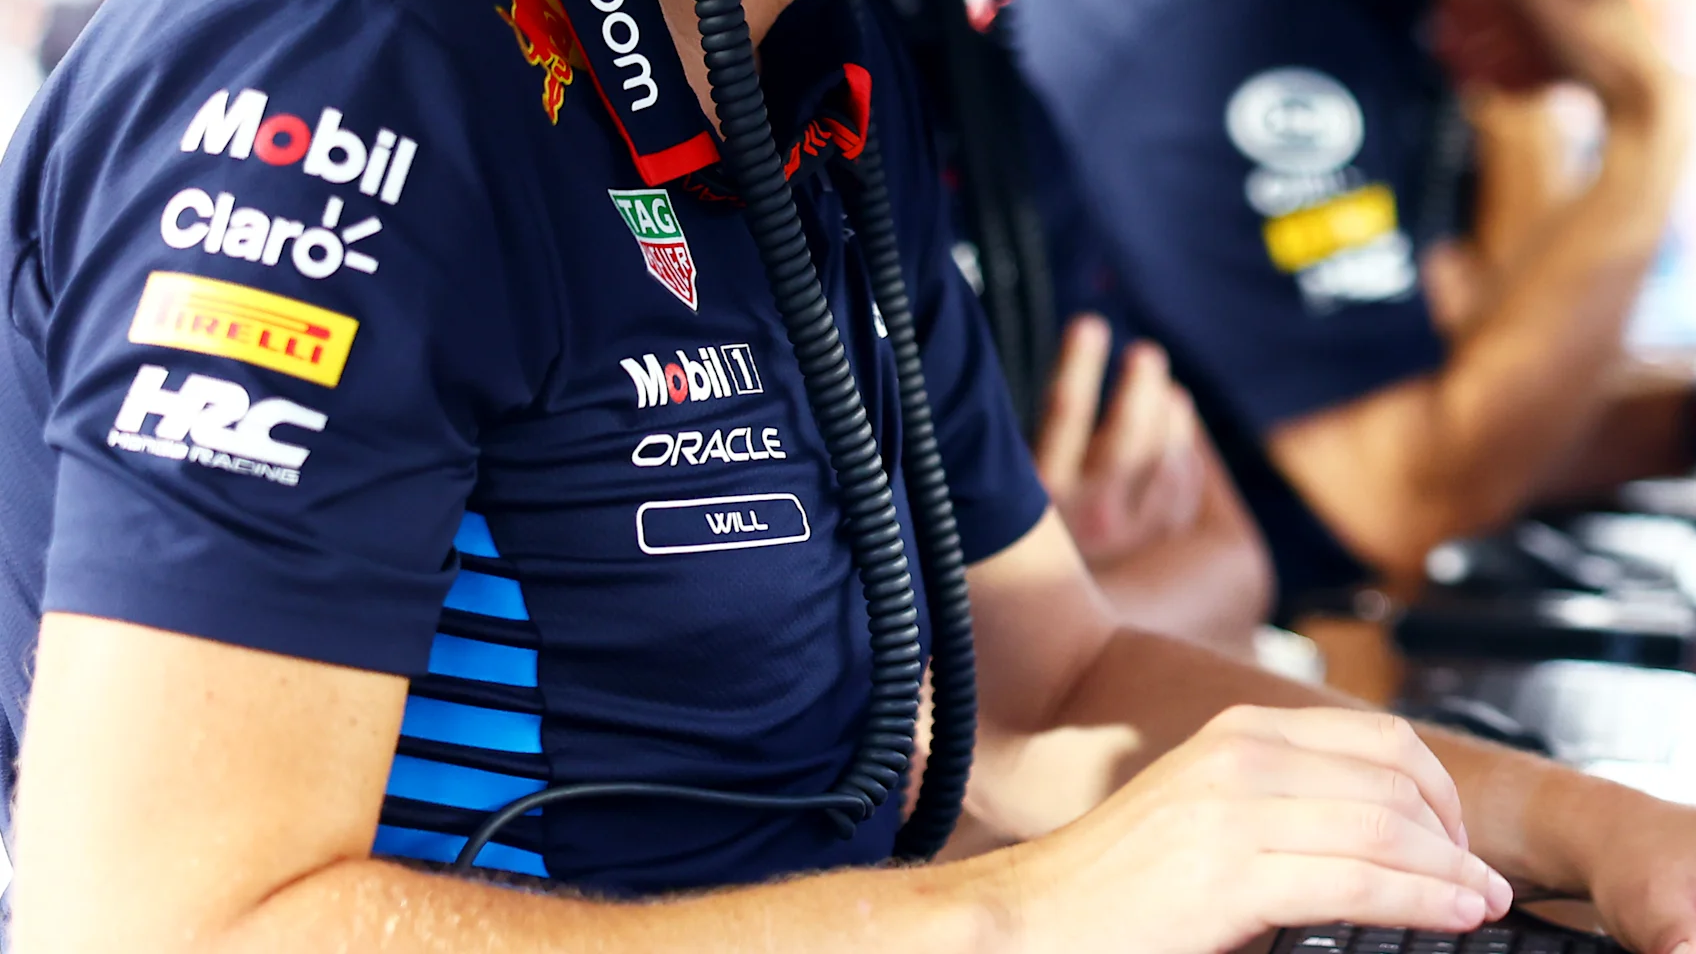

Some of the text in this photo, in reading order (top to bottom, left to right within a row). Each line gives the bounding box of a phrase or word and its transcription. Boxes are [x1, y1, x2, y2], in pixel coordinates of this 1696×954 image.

[181, 88, 418, 205] Mobil
[161, 188, 346, 279] Claro
[618, 197, 677, 234] TAG
[155, 292, 330, 364] PIRELLI
[620, 347, 732, 408] Mobil
[114, 364, 329, 468] HRC
[188, 446, 301, 487] RACING
[632, 427, 786, 467] ORACLE
[705, 510, 769, 535] WILL
